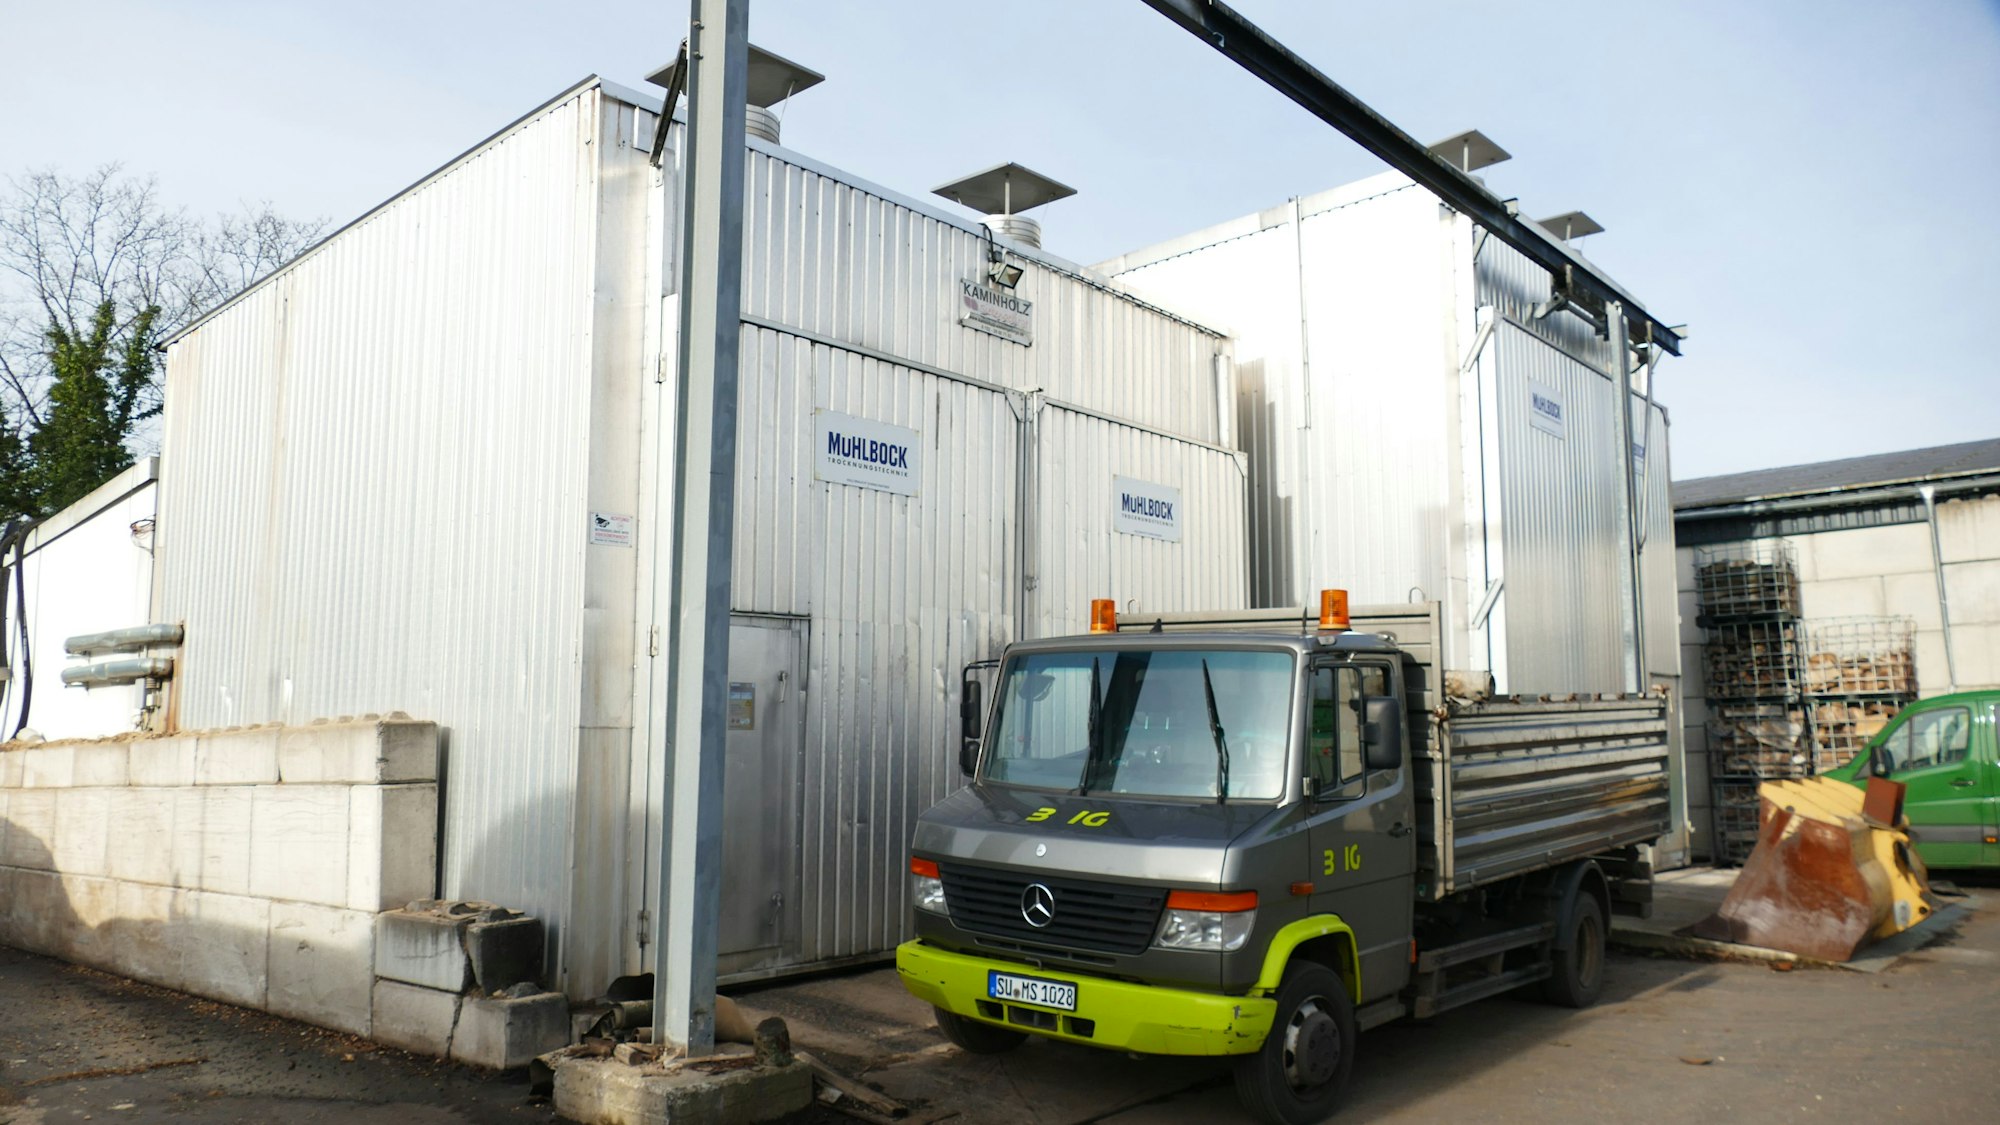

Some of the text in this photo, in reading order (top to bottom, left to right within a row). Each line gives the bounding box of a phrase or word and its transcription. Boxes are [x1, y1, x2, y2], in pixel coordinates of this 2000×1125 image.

[963, 282, 1032, 316] KAMINHOLZ
[828, 457, 908, 477] TROCKNUNGSTECHNIK
[1025, 807, 1057, 822] 3
[1324, 849, 1335, 876] 3
[997, 977, 1074, 1006] SU MS 1028
